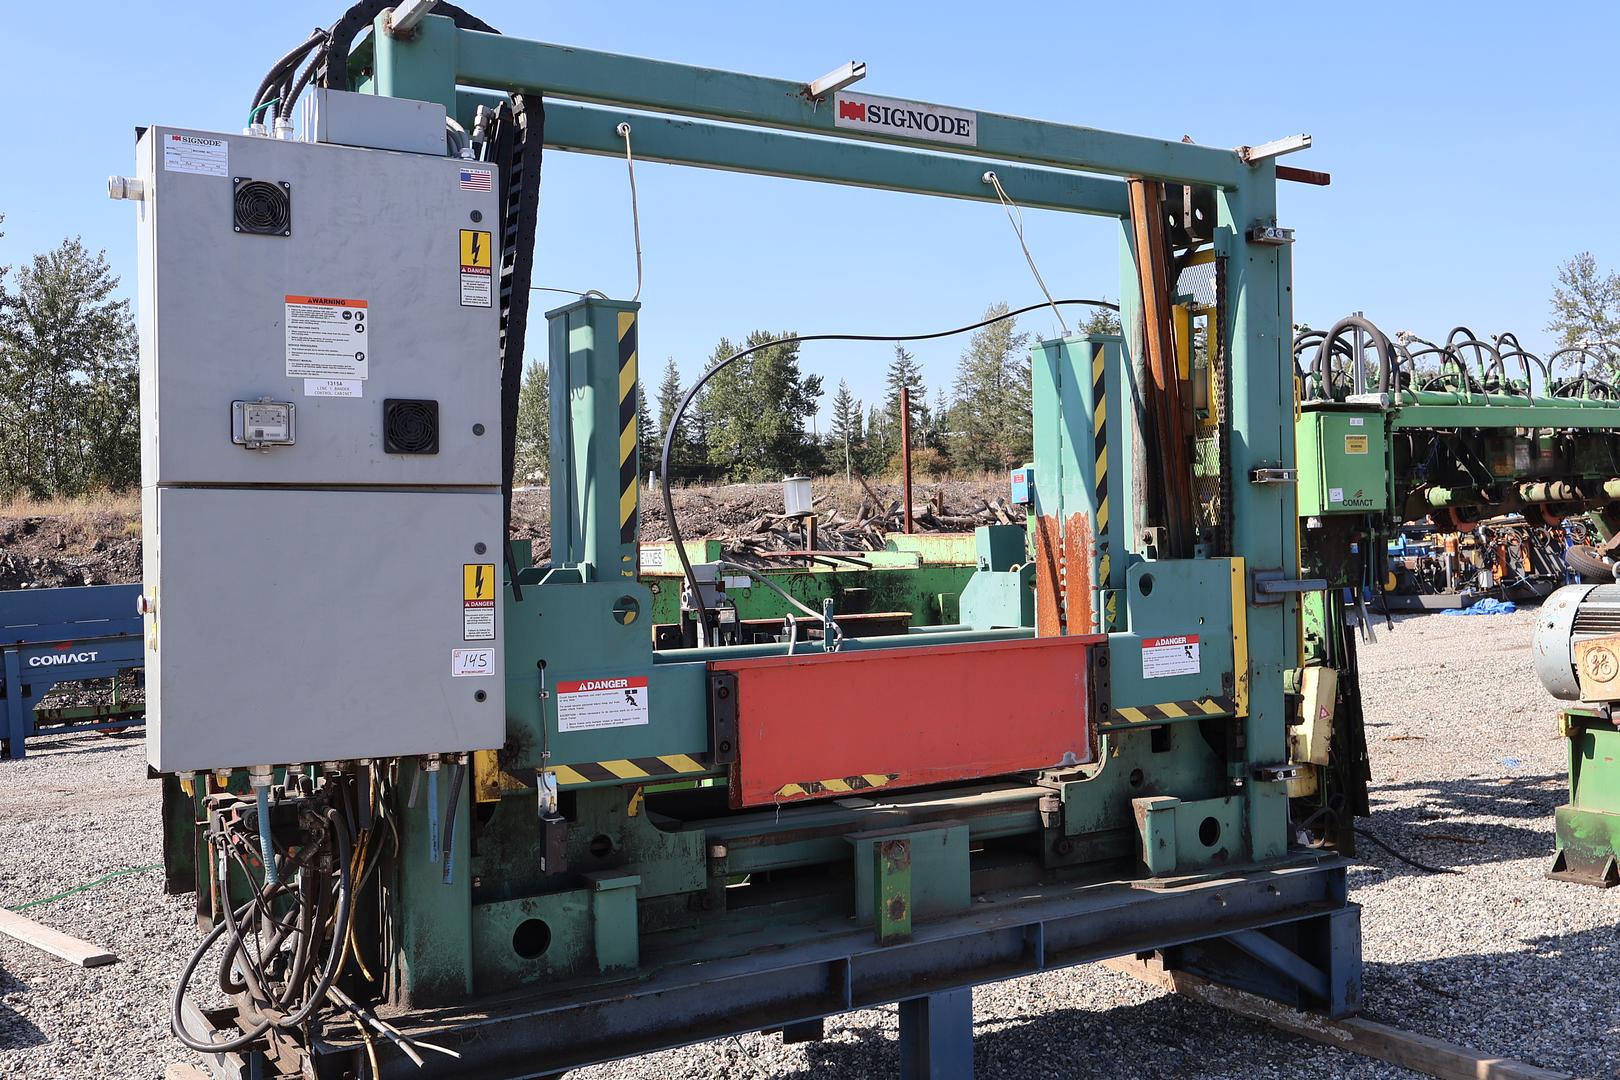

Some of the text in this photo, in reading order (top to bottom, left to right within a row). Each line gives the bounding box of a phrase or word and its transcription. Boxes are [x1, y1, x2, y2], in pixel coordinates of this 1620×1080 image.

[867, 104, 970, 137] SIGNODE
[182, 136, 222, 147] SIGNODE
[467, 266, 491, 275] DANGER
[311, 298, 346, 306] WARNING
[1342, 499, 1374, 507] COMACT
[470, 600, 494, 608] DANGER
[1160, 636, 1187, 646] DANGER
[28, 651, 98, 667] COMACT
[463, 653, 488, 668] 145
[587, 679, 628, 690] DANGER
